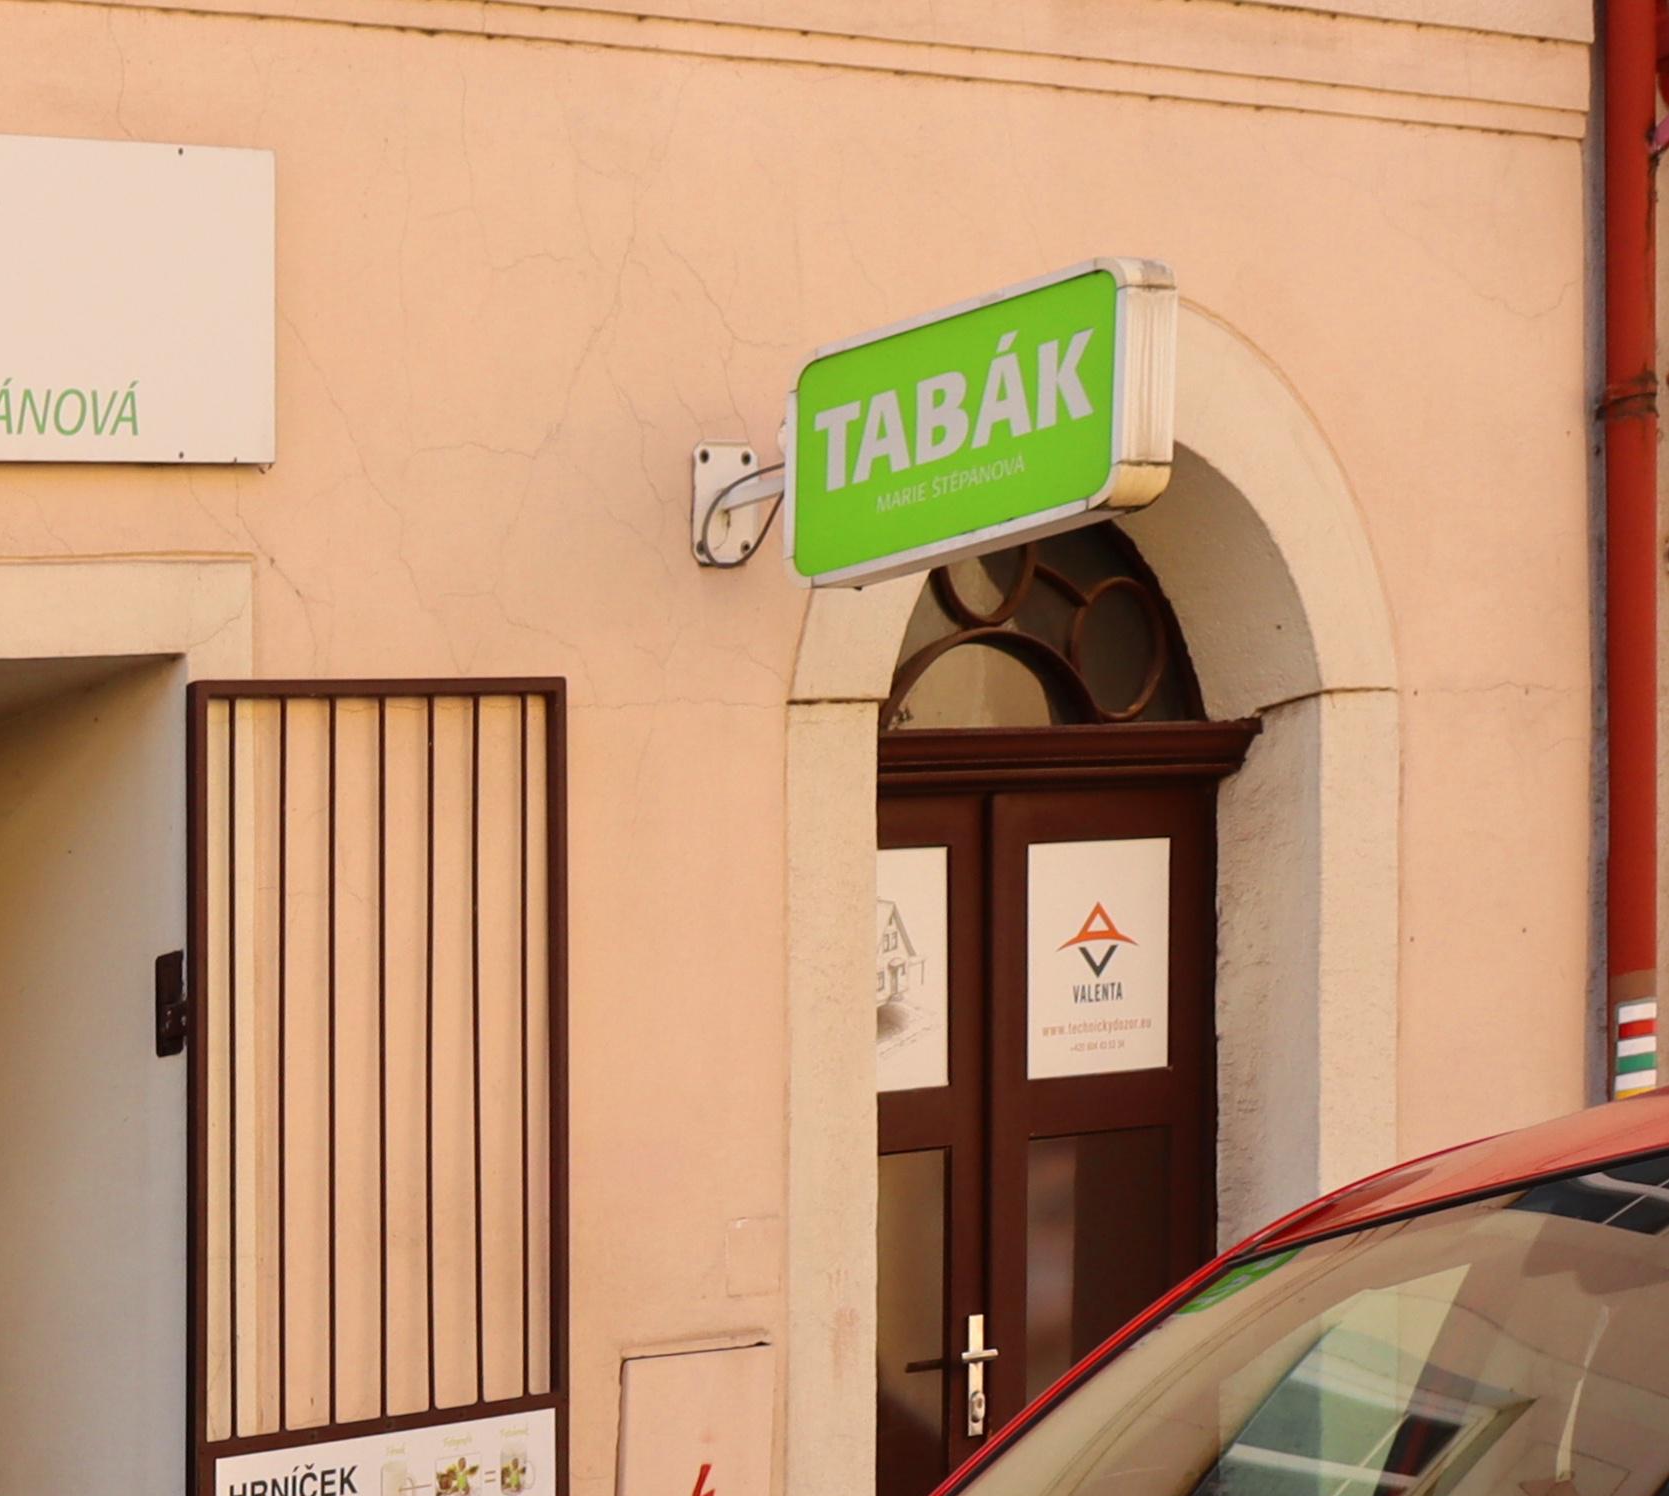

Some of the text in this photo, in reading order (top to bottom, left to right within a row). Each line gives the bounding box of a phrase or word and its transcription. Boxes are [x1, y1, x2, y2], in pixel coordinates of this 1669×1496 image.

[814, 326, 1095, 493] TABÁK
[876, 481, 927, 513] MARIE
[1072, 981, 1124, 1004] VALENTA
